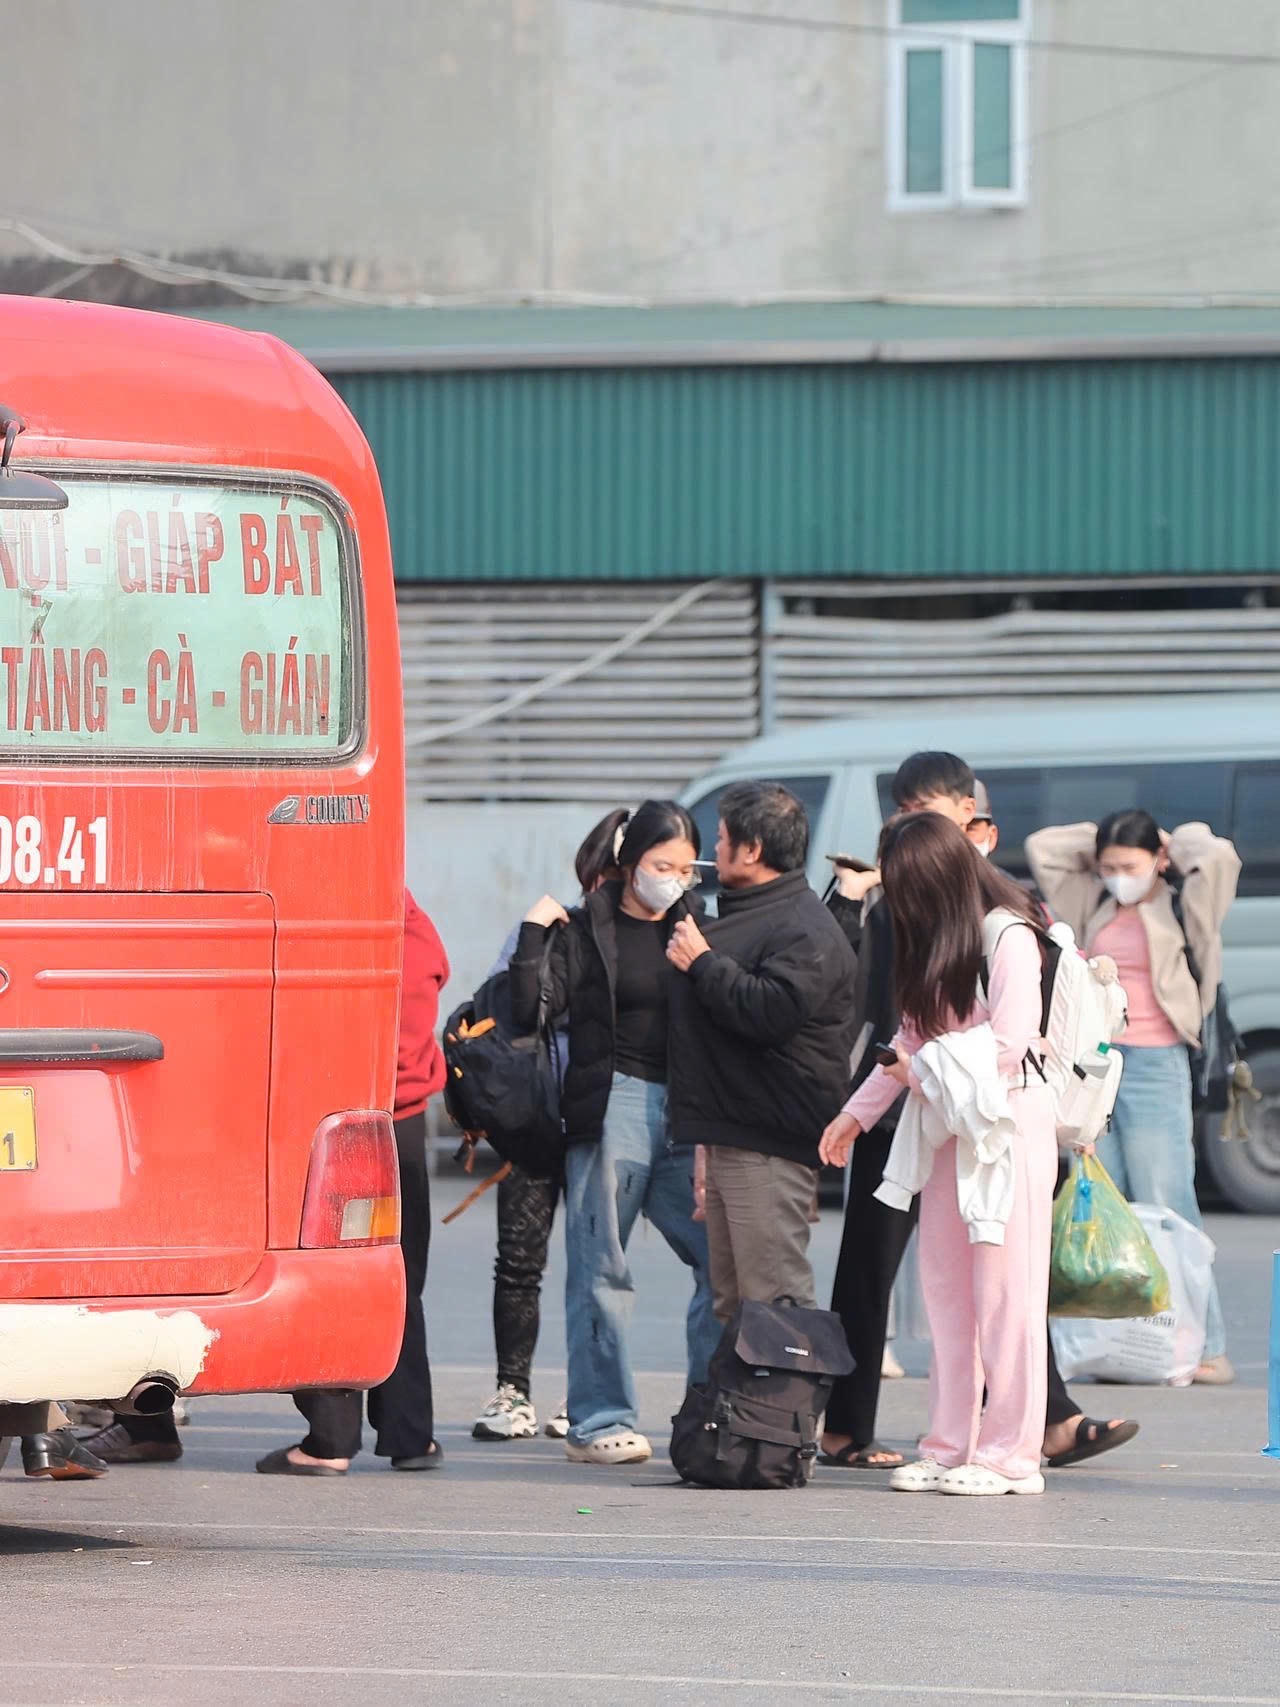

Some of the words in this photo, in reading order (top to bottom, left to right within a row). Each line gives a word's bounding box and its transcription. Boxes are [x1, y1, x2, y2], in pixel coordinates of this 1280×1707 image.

[115, 494, 225, 594] GIÁP
[239, 496, 324, 597] BÁT
[147, 633, 199, 734] CÀ
[240, 636, 330, 736] GIÁN
[306, 794, 370, 824] COUNTY
[3, 1132, 15, 1166] 1
